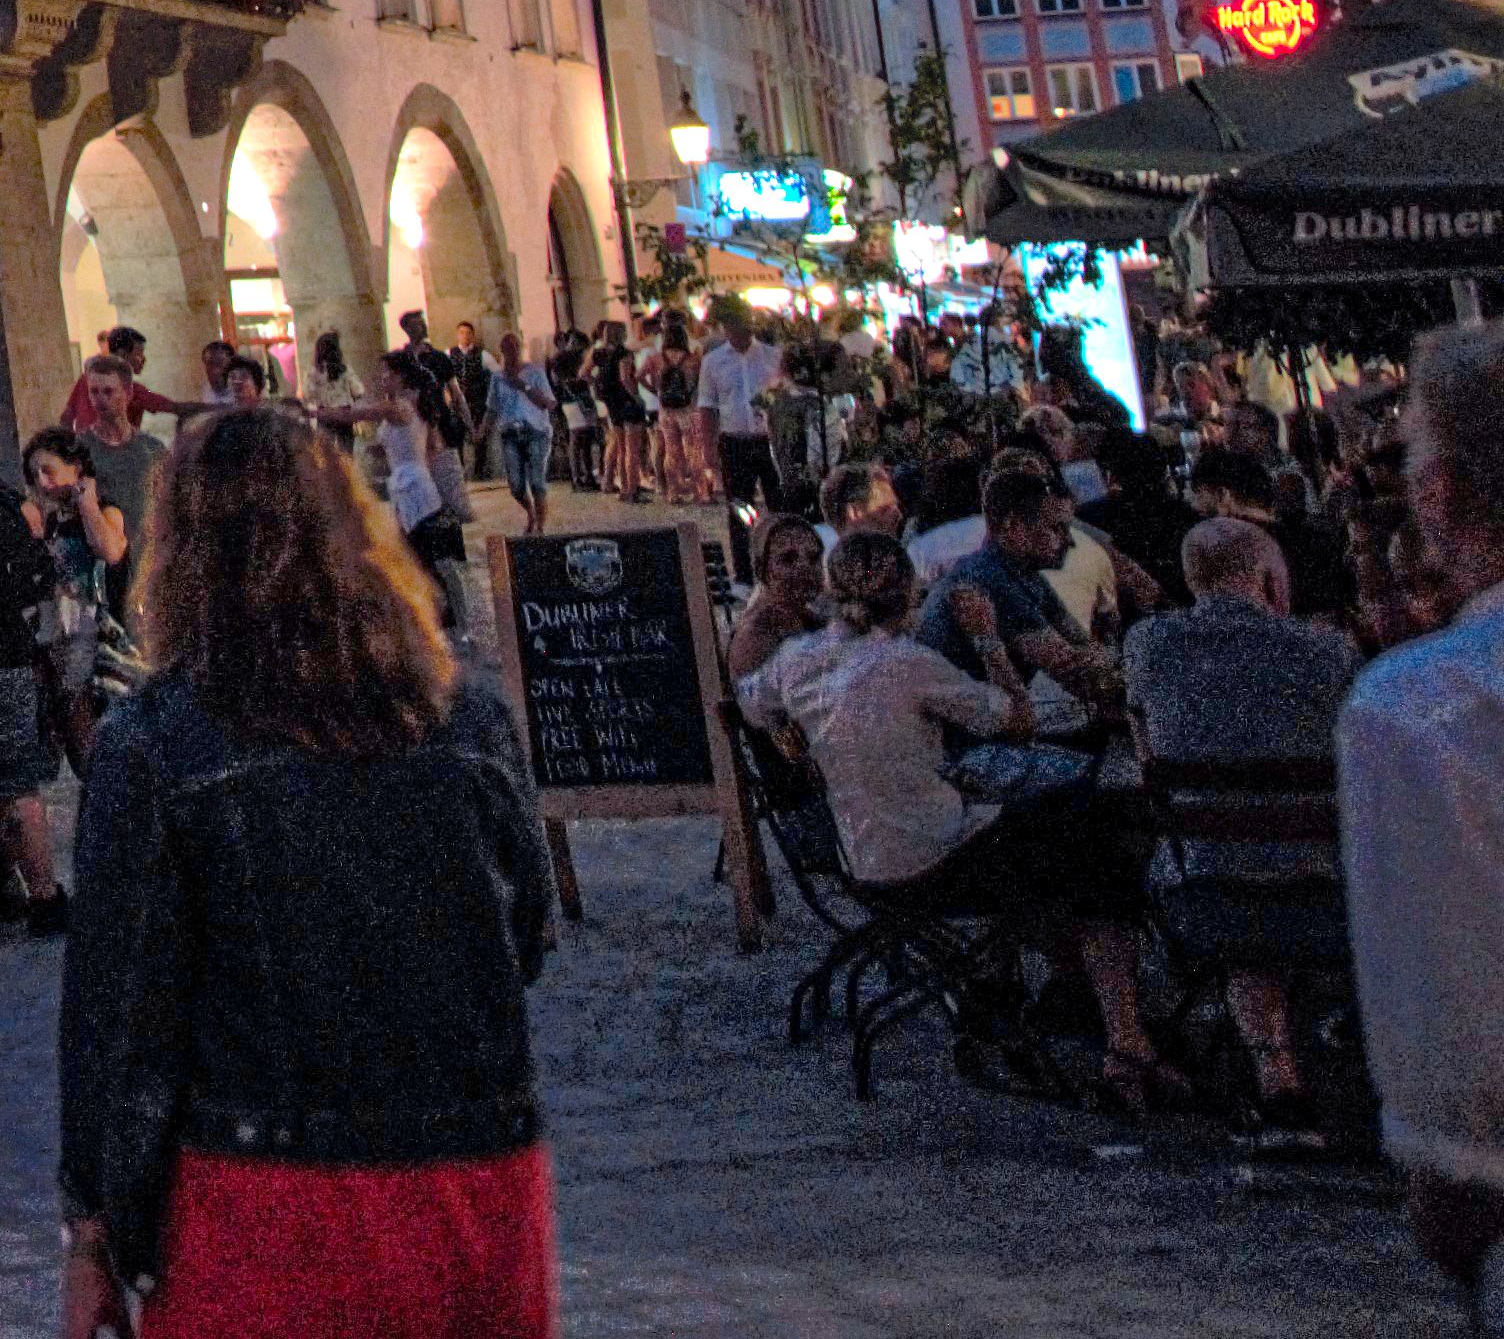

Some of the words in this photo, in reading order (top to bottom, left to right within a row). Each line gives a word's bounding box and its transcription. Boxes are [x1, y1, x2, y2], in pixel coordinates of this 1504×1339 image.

[1218, 1, 1265, 29] Hard
[1293, 204, 1503, 242] Dubliner
[521, 597, 637, 633] DUBLINER
